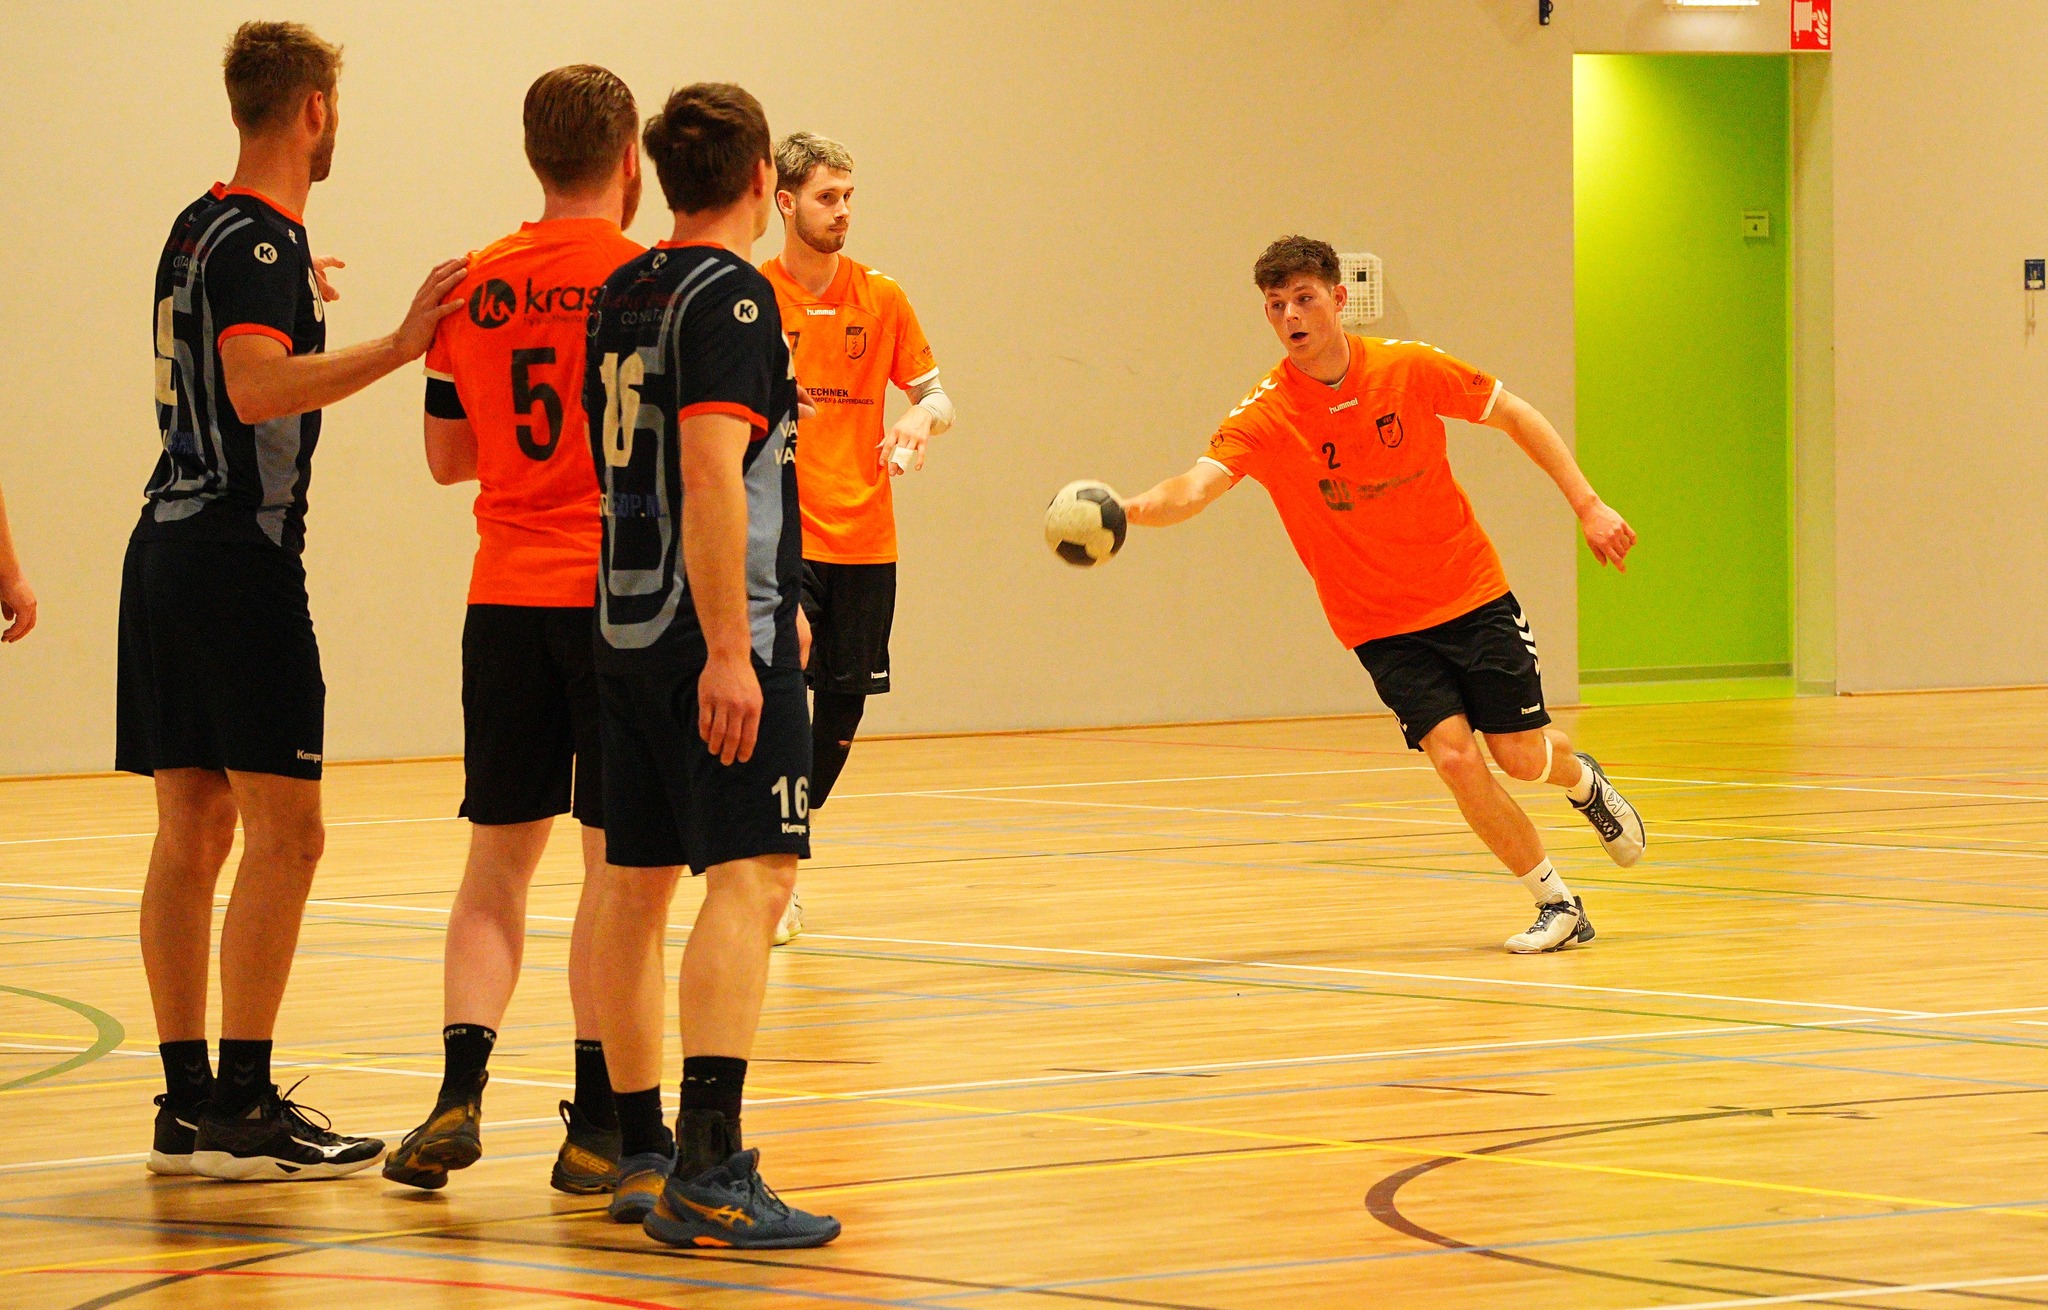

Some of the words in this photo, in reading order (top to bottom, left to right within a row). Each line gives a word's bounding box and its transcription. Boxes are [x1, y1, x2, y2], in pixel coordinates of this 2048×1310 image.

[806, 308, 836, 316] hummel
[511, 346, 564, 461] 5
[805, 387, 849, 398] TECHNIEK
[1328, 397, 1359, 414] hummel
[1321, 442, 1341, 470] 2
[771, 775, 809, 819] 16
